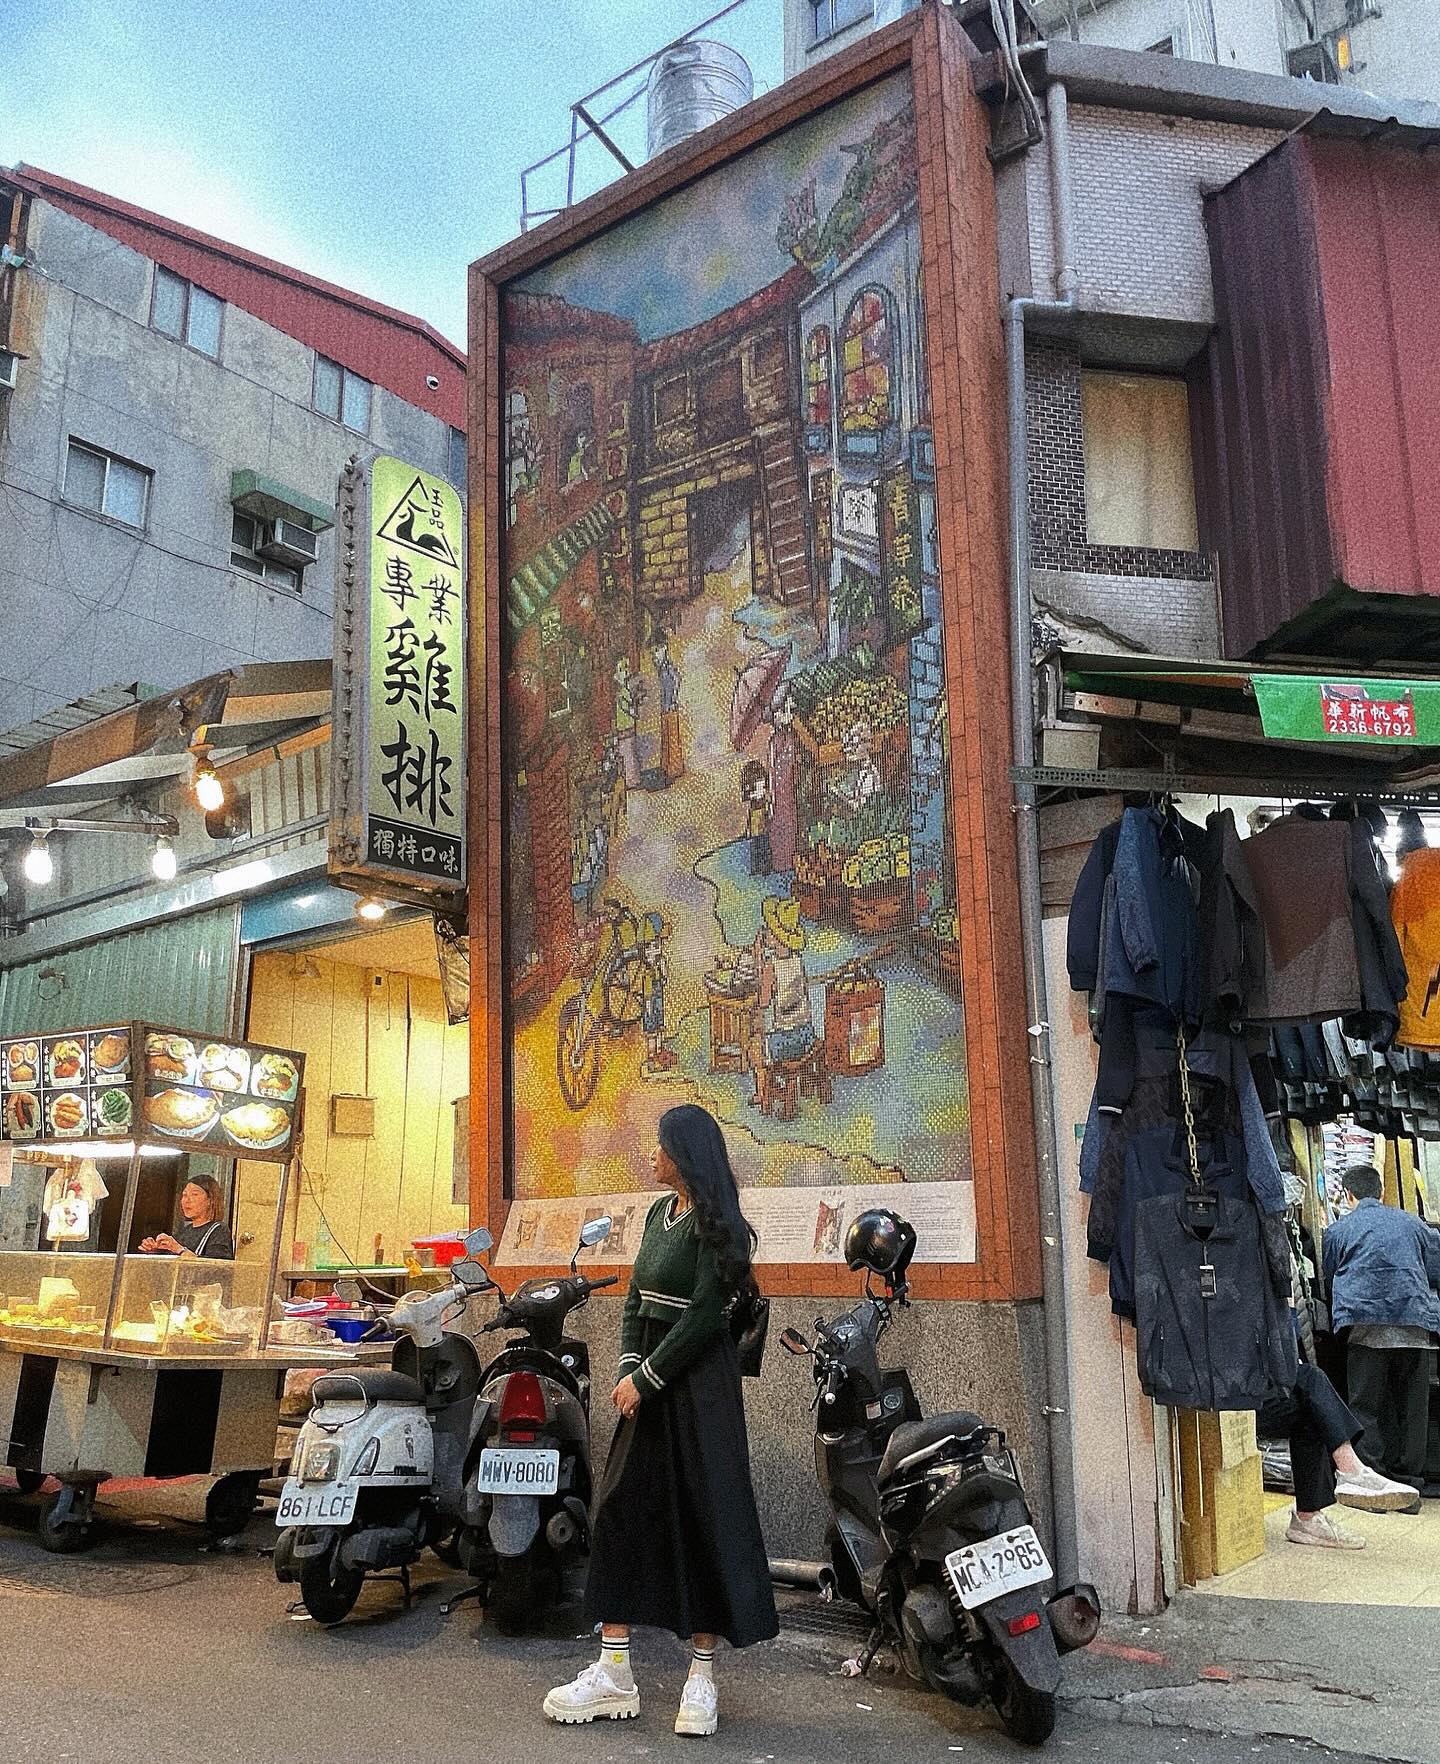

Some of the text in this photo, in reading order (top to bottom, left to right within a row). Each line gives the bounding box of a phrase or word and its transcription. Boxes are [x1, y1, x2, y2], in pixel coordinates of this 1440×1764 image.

[379, 555, 461, 627] 專業
[1327, 701, 1409, 723] 華新帆布
[1329, 719, 1412, 736] 2336-6792
[373, 828, 459, 874] 獨特口味
